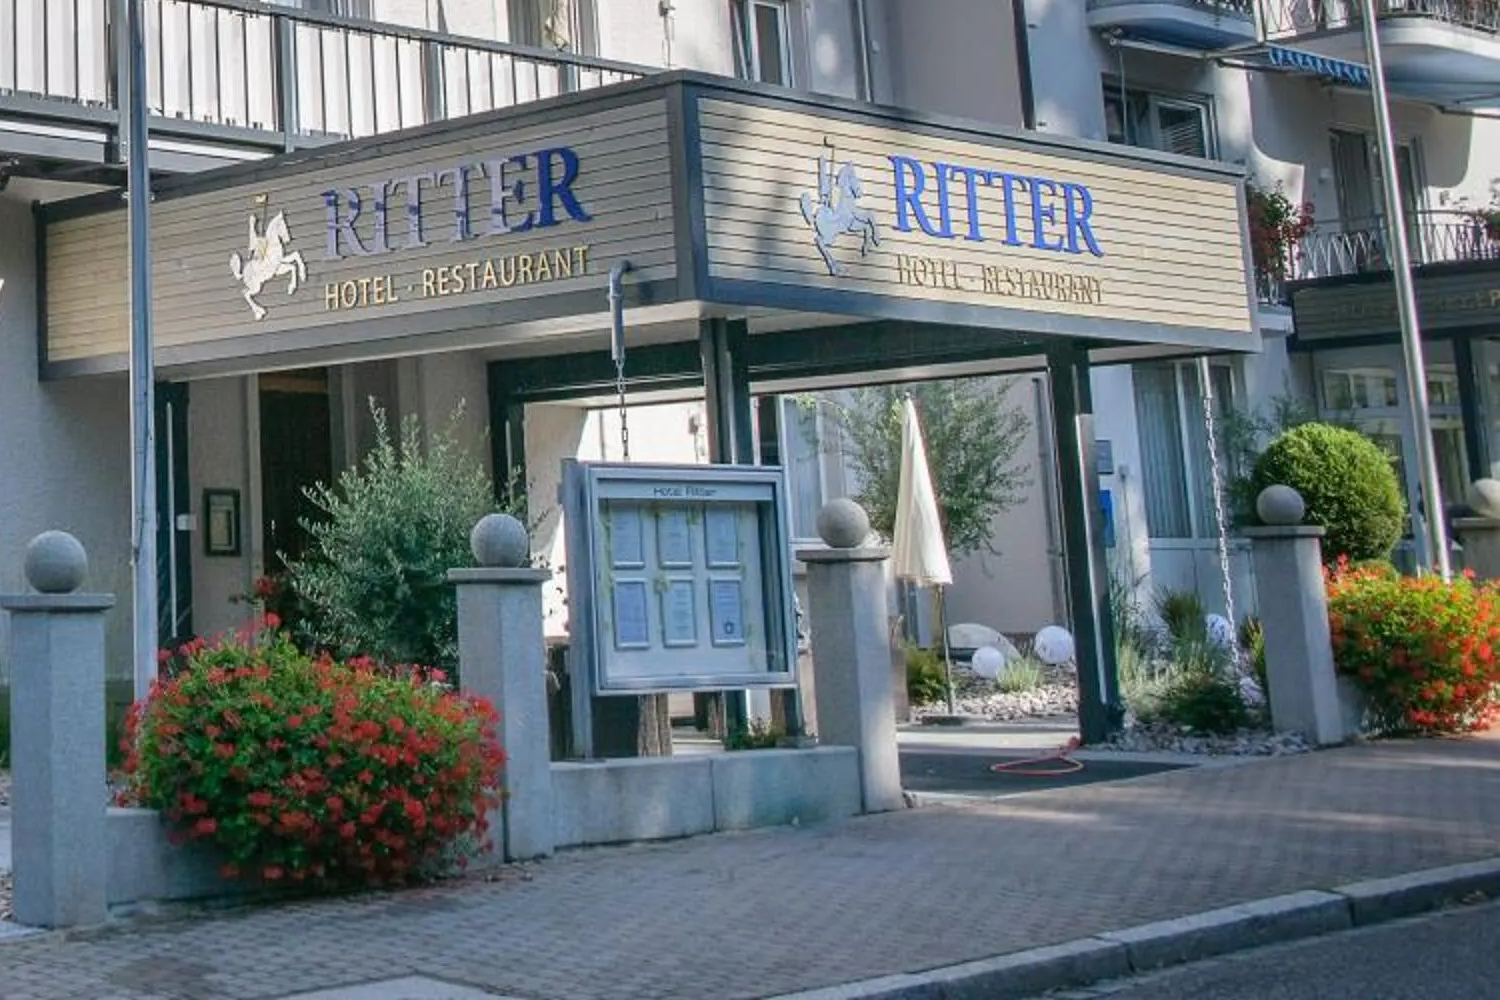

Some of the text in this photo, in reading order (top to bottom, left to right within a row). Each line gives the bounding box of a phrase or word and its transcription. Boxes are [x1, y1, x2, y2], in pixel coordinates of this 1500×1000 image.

[320, 145, 593, 261] RITTER
[888, 154, 1105, 258] RITTER
[324, 245, 590, 311] HOTEL RESTAURANT
[898, 253, 1104, 305] HOTEL RESTAURANT
